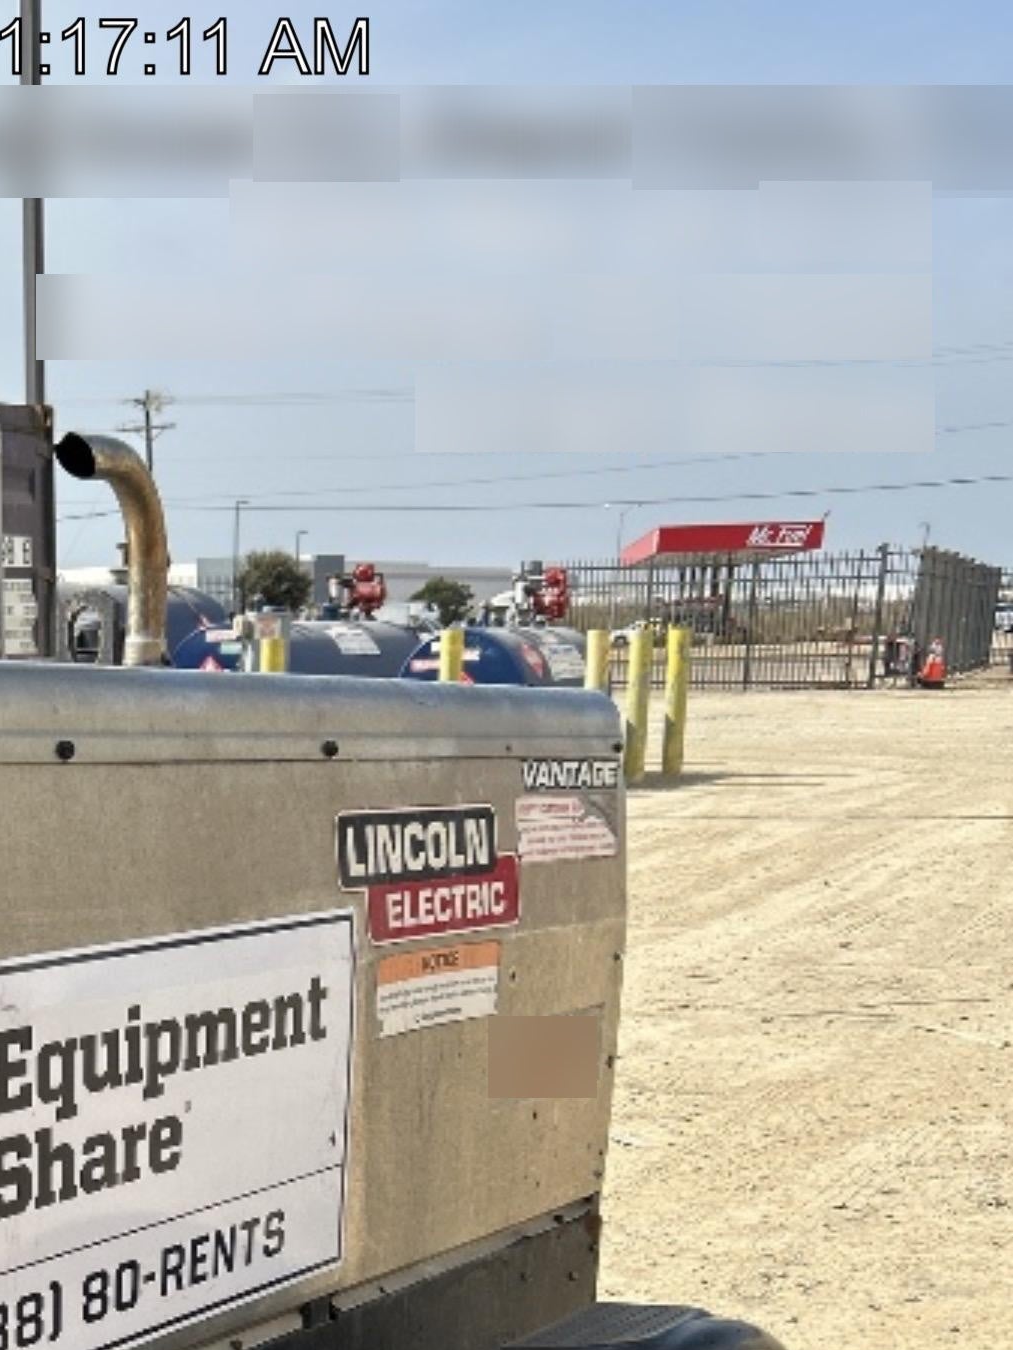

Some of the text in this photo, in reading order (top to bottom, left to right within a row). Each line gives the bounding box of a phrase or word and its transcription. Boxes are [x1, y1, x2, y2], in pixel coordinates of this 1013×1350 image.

[523, 761, 618, 787] VANTAGE
[345, 818, 489, 878] LINCOLN
[387, 881, 506, 929] ELECTRIC
[82, 1208, 286, 1323] 80-RENTS
